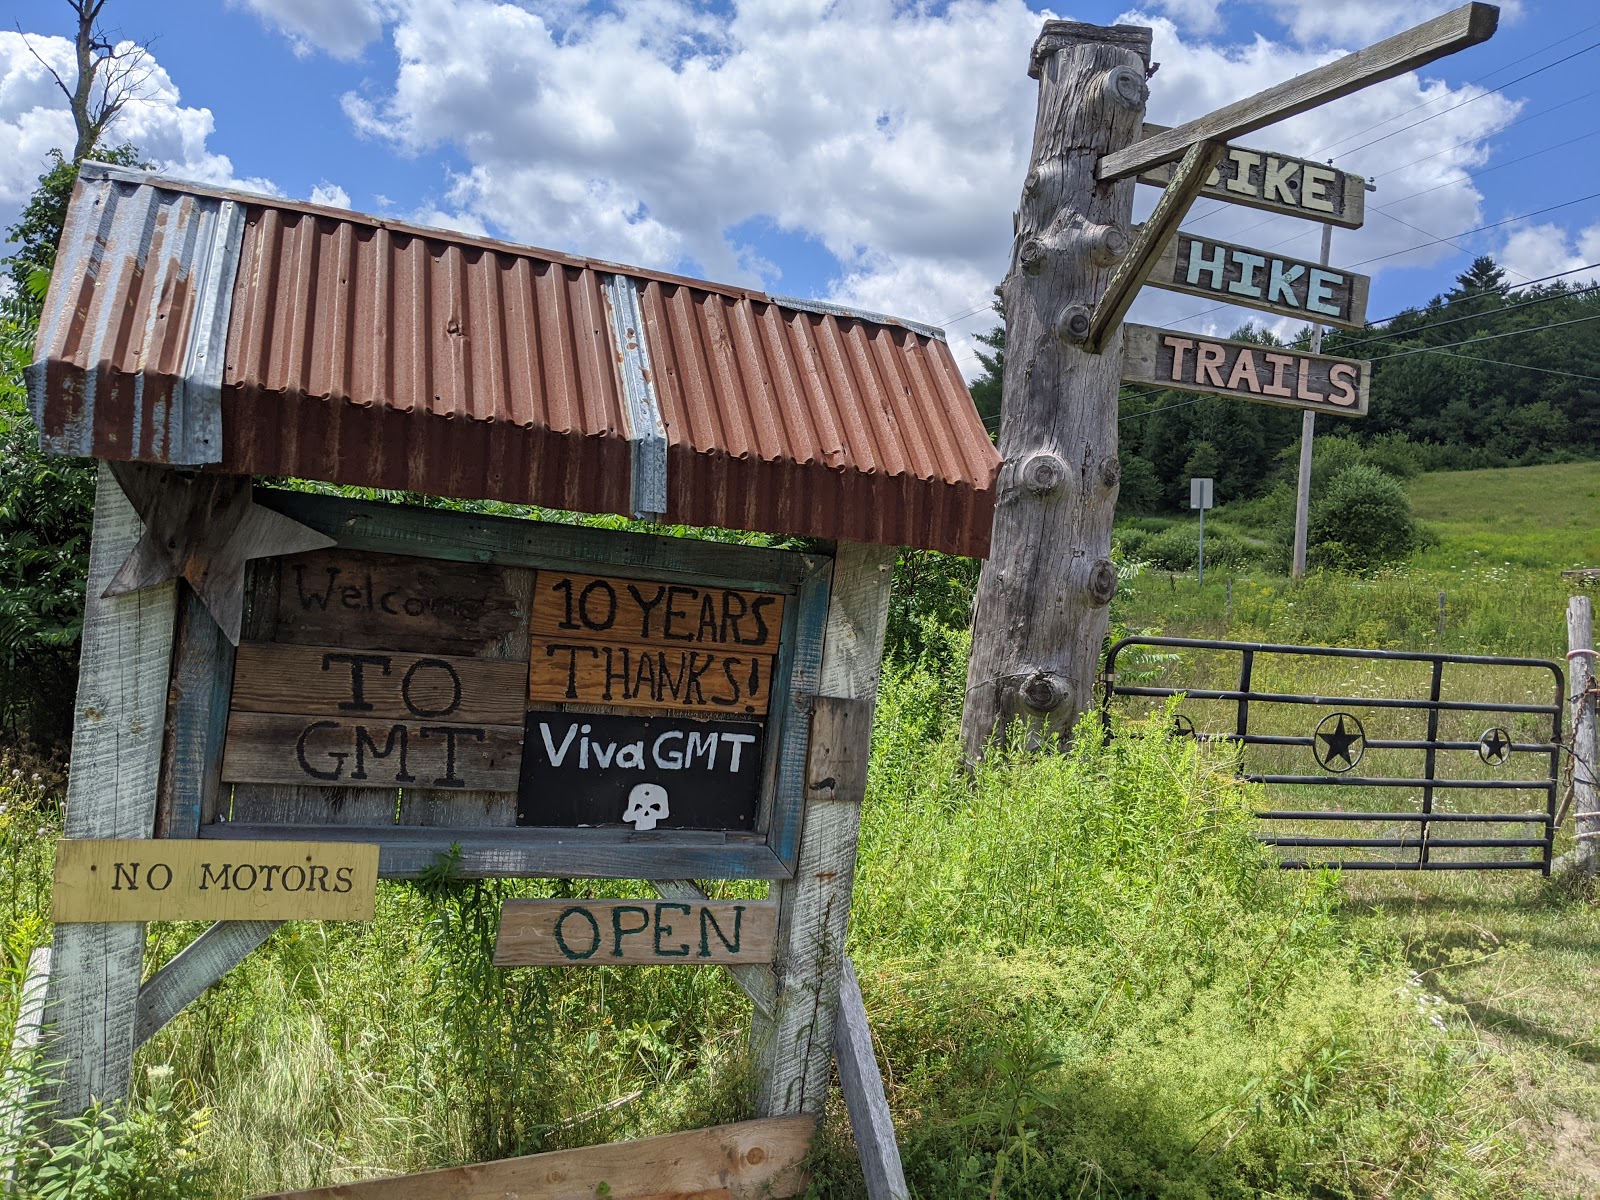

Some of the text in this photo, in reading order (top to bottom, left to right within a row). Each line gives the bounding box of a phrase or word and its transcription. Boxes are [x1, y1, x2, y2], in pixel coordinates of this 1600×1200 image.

[1185, 240, 1345, 317] HIKE
[1163, 336, 1358, 407] TRAILS
[291, 564, 488, 622] Welco
[552, 578, 776, 646] 10 YEARS
[320, 653, 462, 718] TO
[546, 644, 760, 714] THANKS!
[296, 720, 486, 788] GMT
[111, 862, 354, 893] NO MOTORS
[554, 902, 746, 960] OPEN
